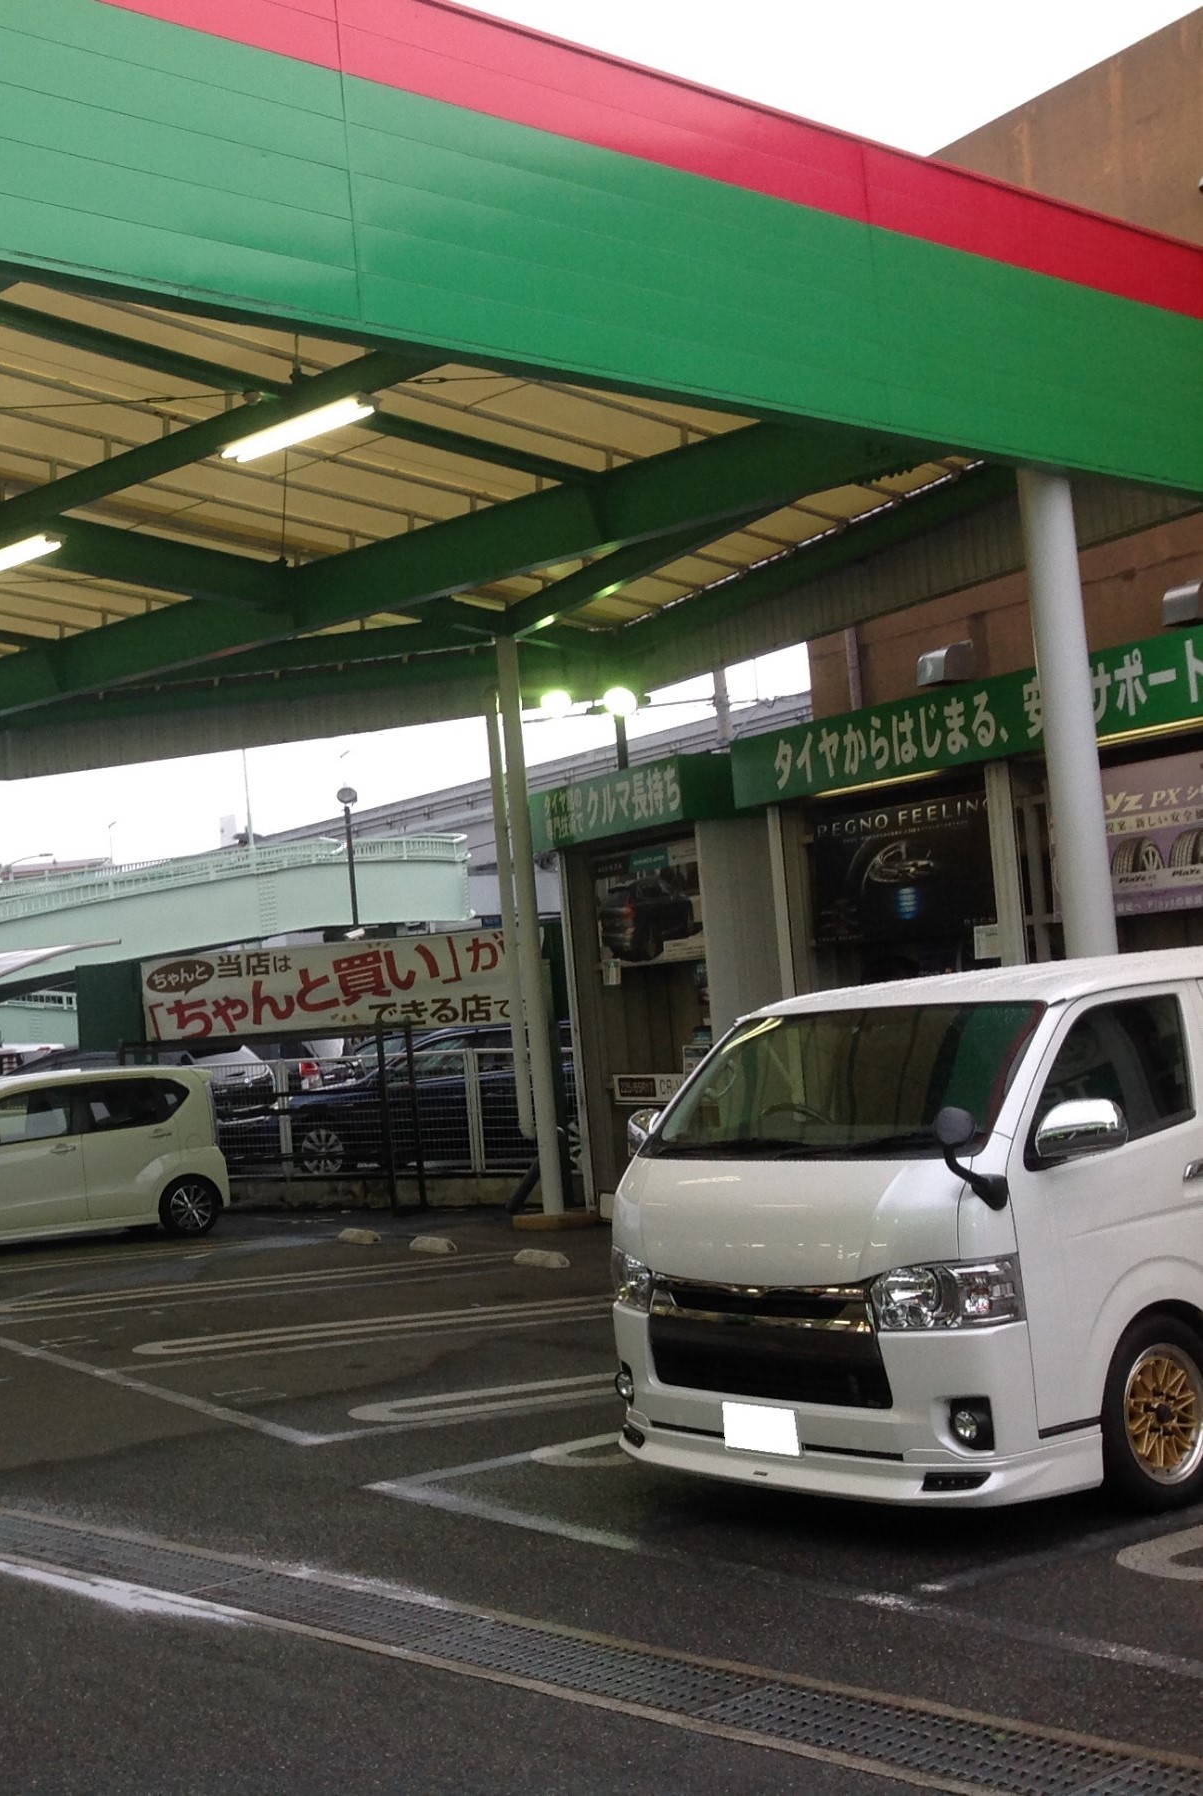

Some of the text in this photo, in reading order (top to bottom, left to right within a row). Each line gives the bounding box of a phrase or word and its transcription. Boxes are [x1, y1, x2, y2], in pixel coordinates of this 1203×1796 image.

[817, 813, 889, 839] REGNO
[150, 963, 210, 991] ちゃんと
[217, 952, 292, 979] 当店は
